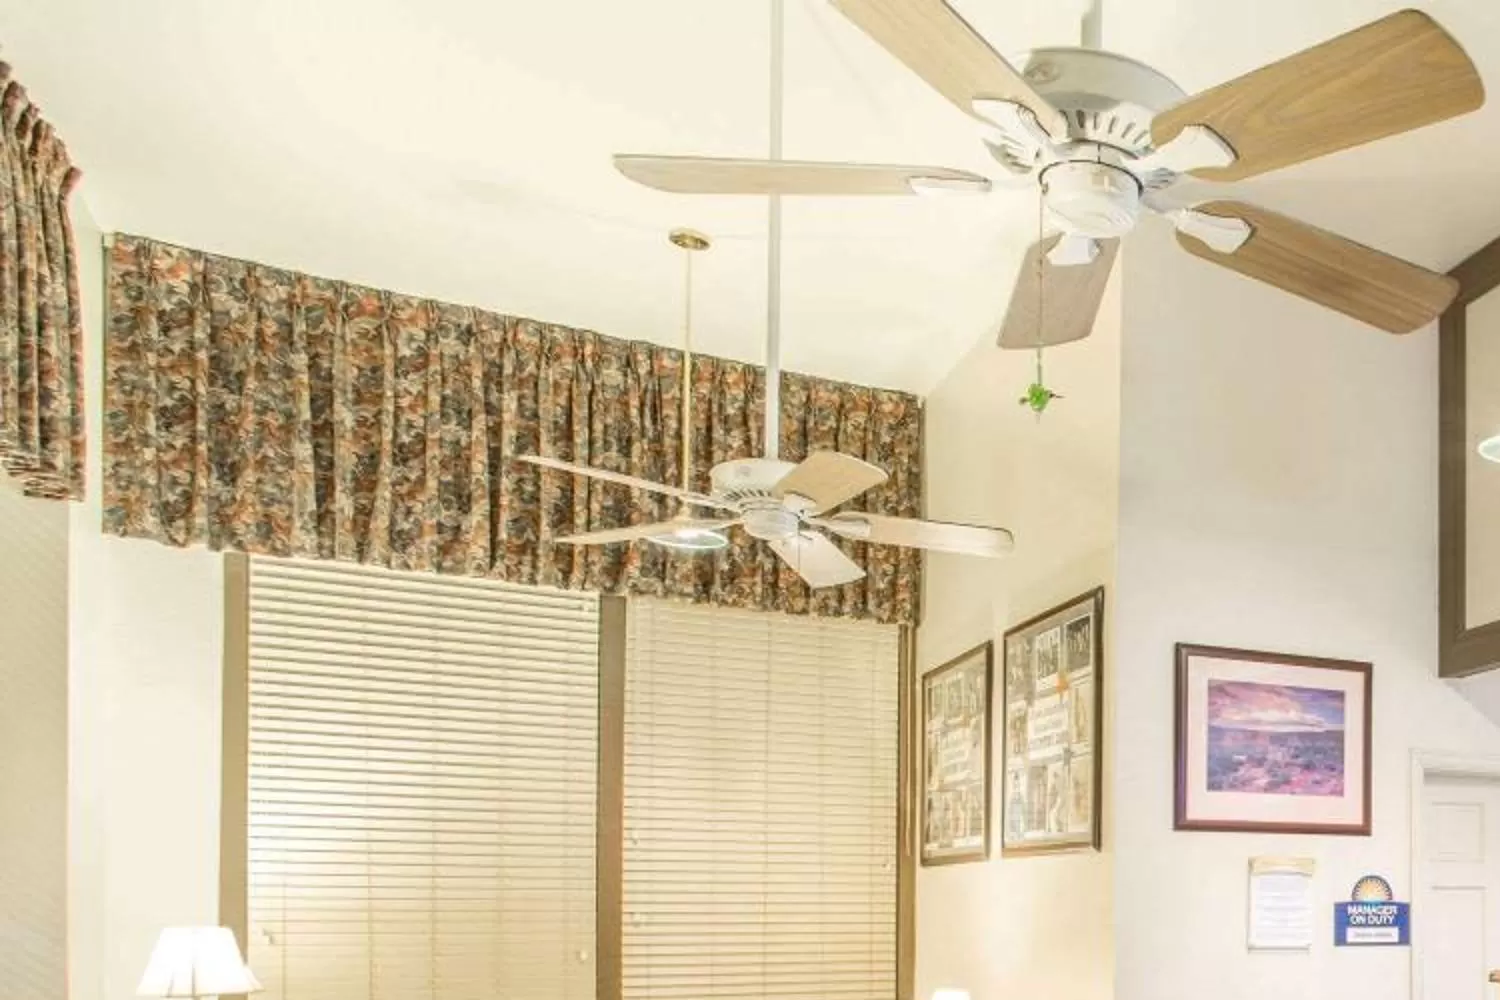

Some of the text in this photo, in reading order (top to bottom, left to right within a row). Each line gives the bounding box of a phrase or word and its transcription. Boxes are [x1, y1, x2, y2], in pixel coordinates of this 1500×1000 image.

[1348, 904, 1398, 916] MANAGER
[1350, 915, 1395, 925] ON DUTY
